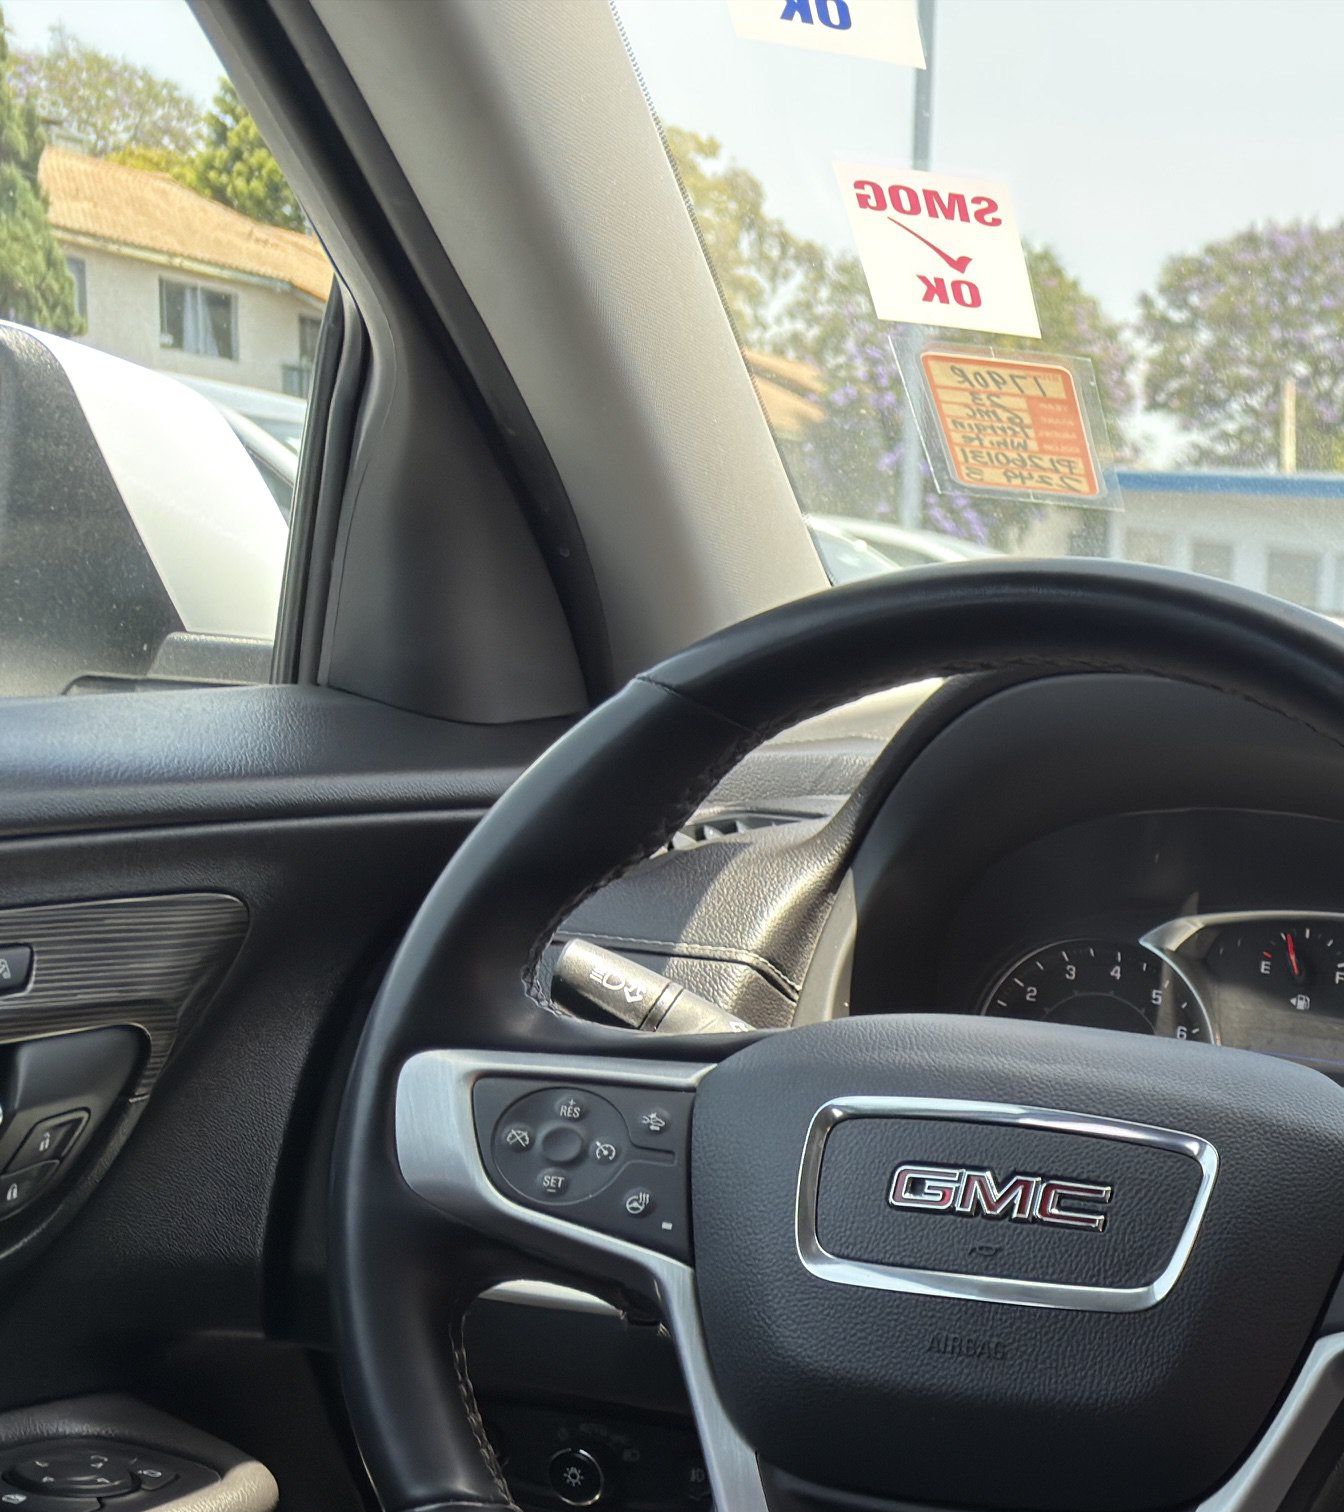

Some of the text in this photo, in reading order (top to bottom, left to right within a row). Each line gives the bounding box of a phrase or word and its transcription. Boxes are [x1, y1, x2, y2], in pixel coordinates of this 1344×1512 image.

[1065, 965, 1076, 980] 3
[1110, 965, 1121, 980] 4
[1260, 960, 1272, 975] E
[1025, 986, 1037, 1002] 2
[1151, 989, 1163, 1006] 5
[1176, 1025, 1187, 1040] 6
[560, 1104, 581, 1119] RES
[543, 1175, 565, 1188] SET
[888, 1164, 1113, 1232] GMC
[926, 1333, 1007, 1361] AIRBAG
